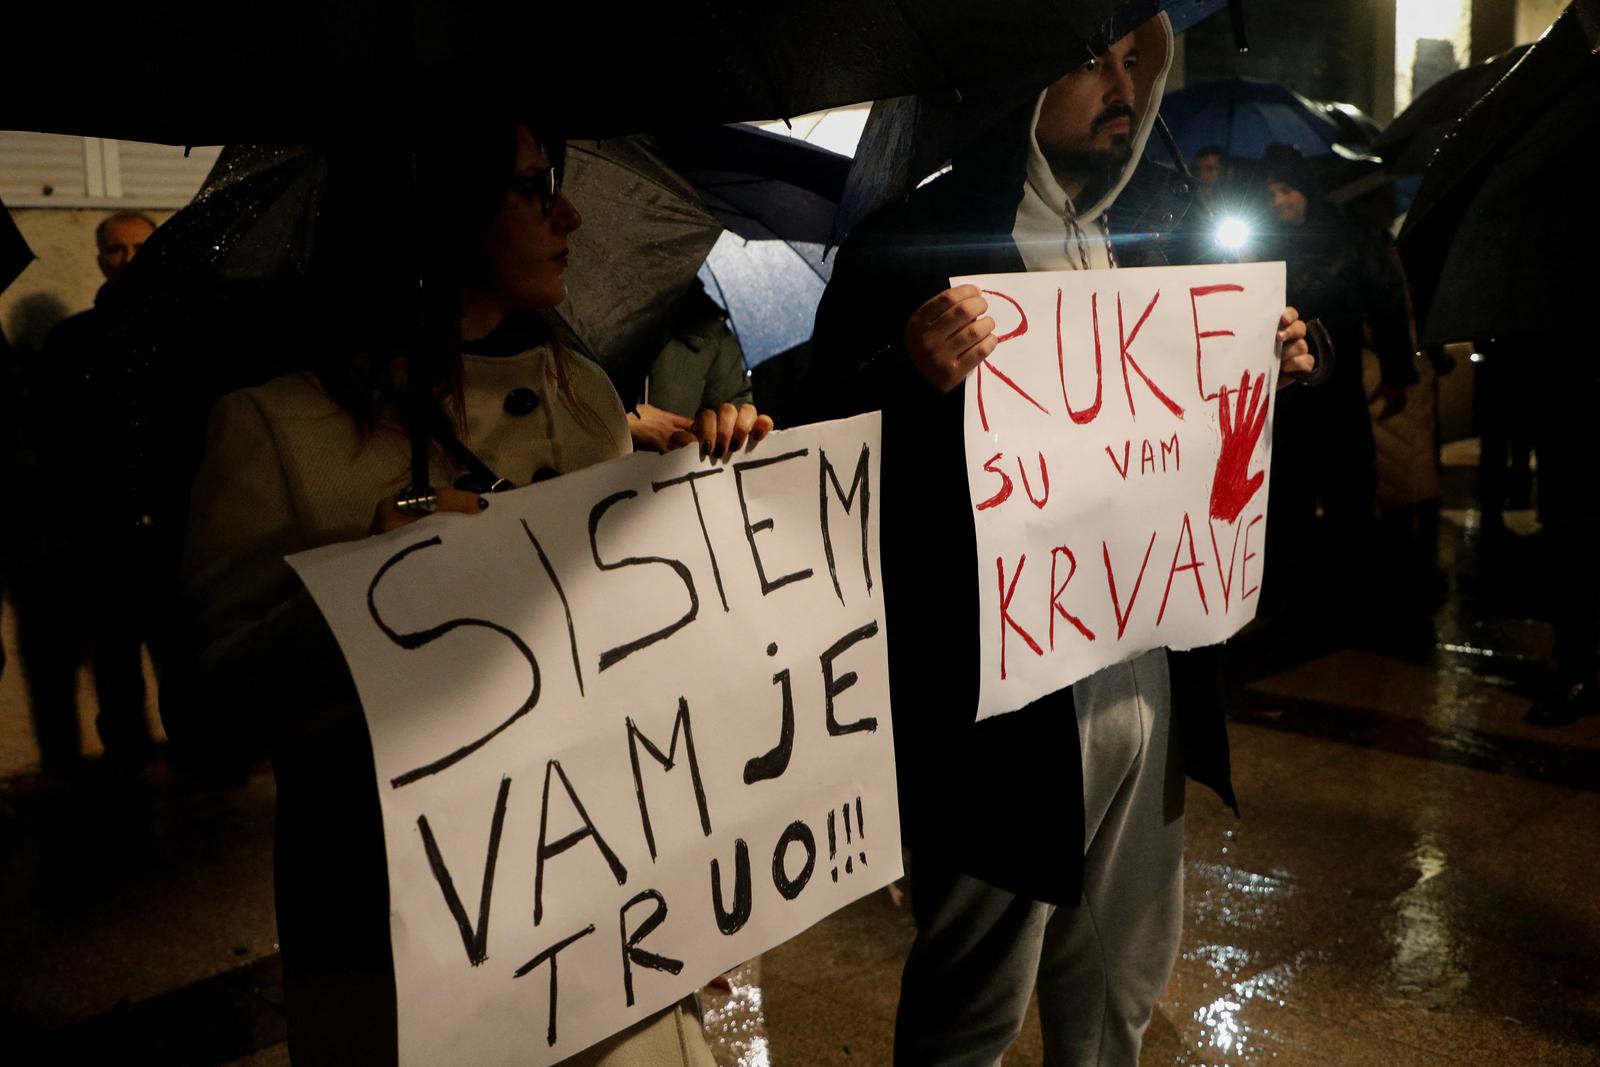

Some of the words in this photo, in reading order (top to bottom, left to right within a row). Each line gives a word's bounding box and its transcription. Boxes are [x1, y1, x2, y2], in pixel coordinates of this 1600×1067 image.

[976, 284, 1251, 431] RUKE
[976, 451, 1050, 511] SU
[1105, 434, 1180, 480] VAM
[368, 442, 873, 789] SISTEM
[996, 513, 1263, 680] KRVAVE
[415, 696, 712, 967] VAM
[512, 796, 868, 1047] TRUO!!!
